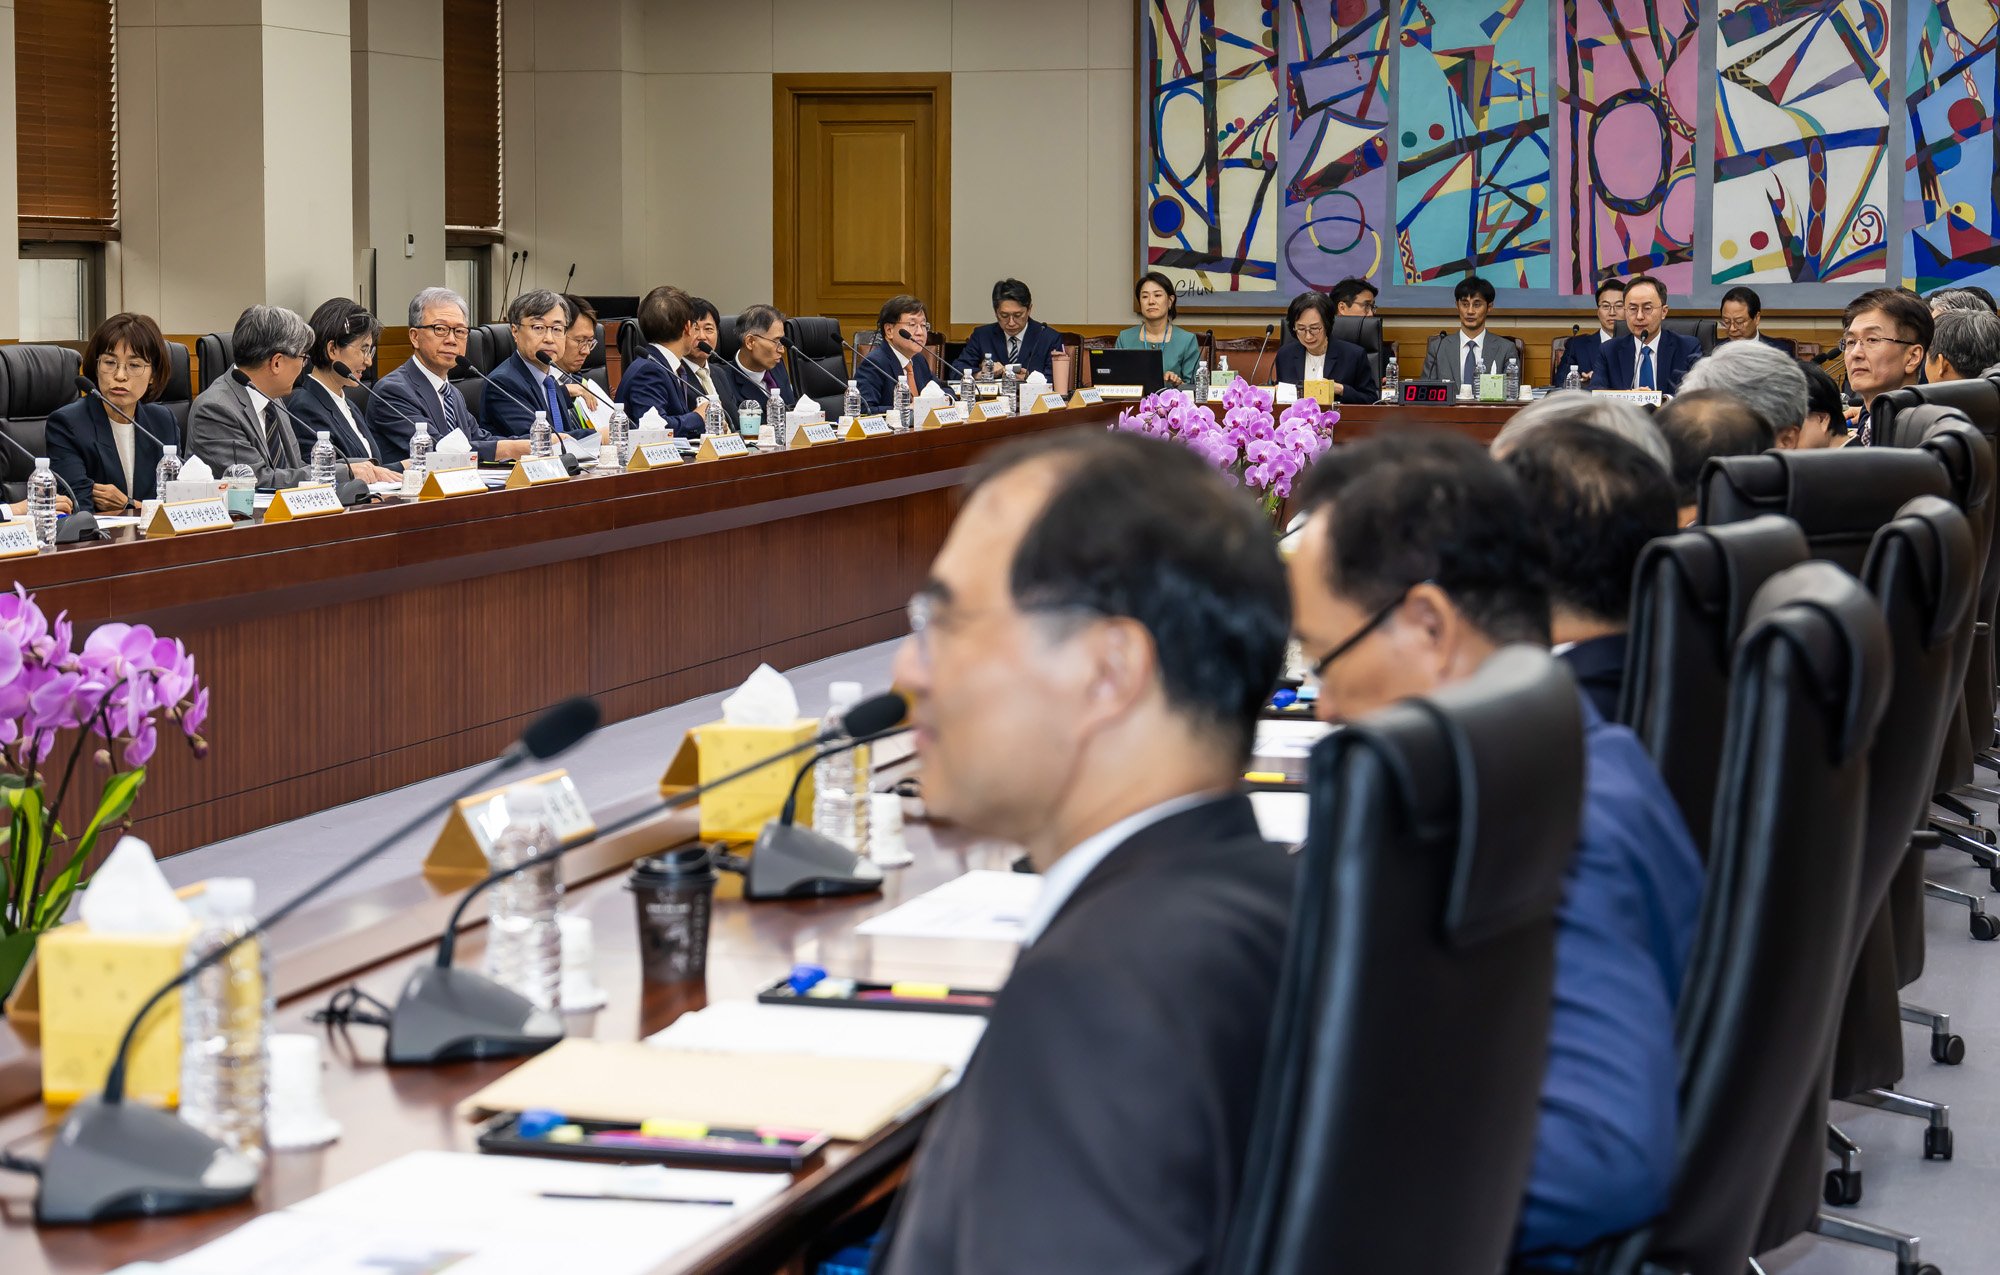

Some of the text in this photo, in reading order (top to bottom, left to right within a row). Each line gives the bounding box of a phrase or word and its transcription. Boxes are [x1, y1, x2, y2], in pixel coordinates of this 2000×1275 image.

[289, 490, 336, 510] 인천가정법원장
[170, 505, 226, 525] 의정부지방법원장
[0, 529, 31, 549] 방법원장
